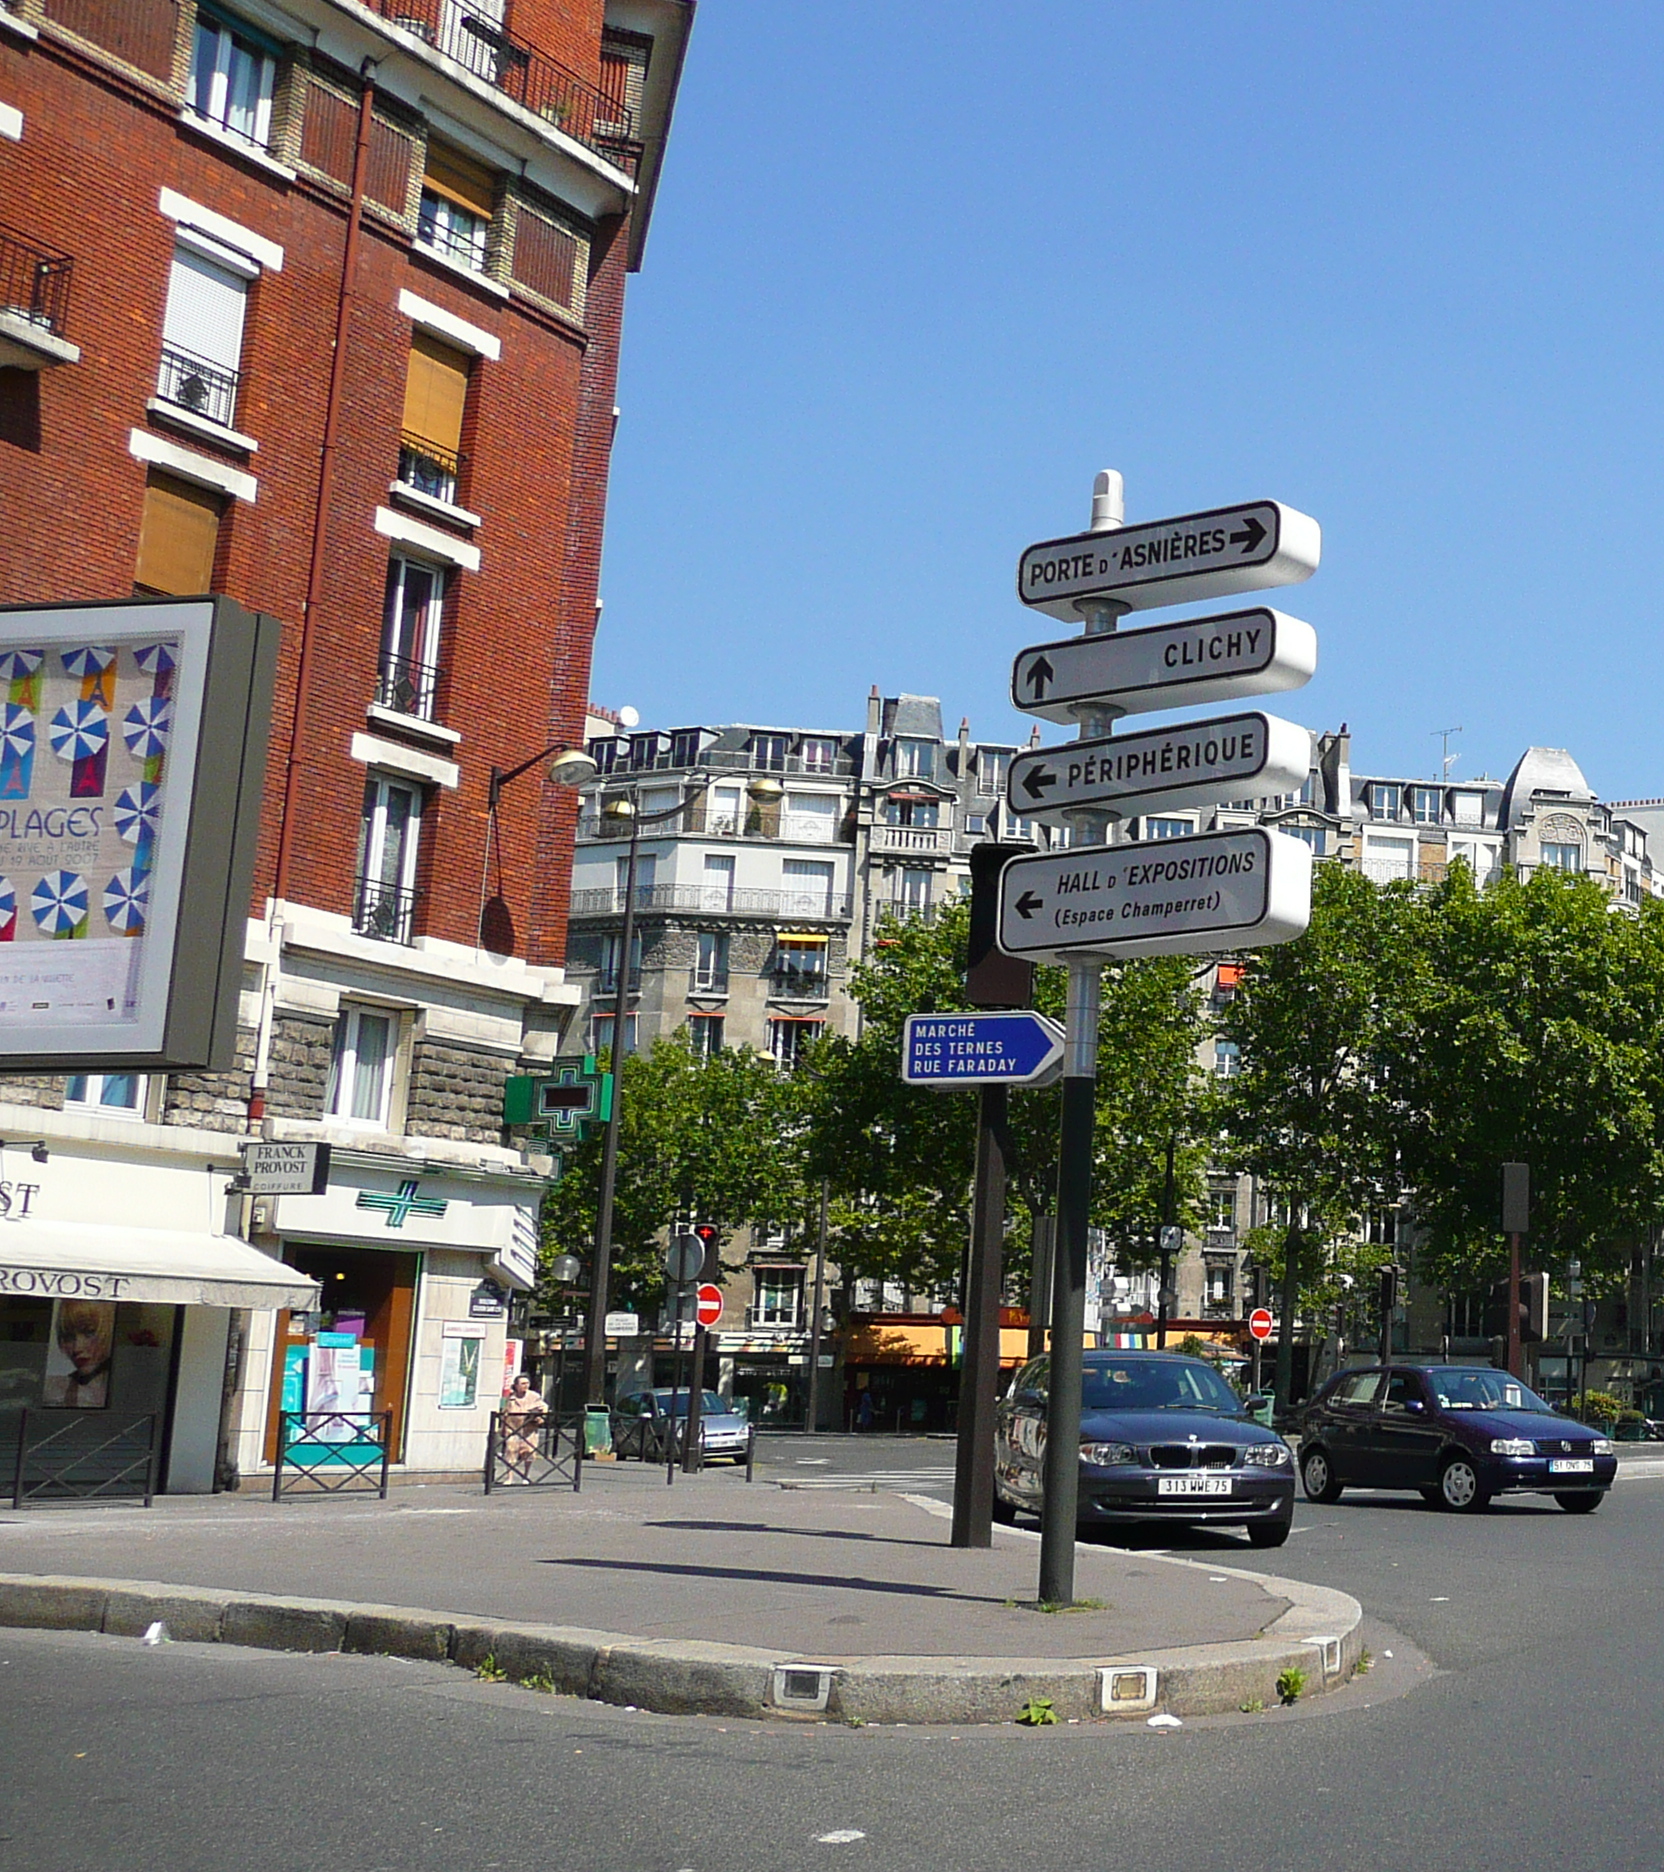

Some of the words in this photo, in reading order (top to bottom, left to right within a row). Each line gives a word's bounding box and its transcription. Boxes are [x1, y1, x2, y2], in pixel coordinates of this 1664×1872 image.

[1030, 553, 1094, 587] PORTE
[1164, 629, 1261, 668] CLICHY
[1068, 733, 1254, 788] PÉRIPHÉRIQUE
[1057, 871, 1100, 894] HALL
[1054, 908, 1114, 928] (Espace
[1121, 891, 1220, 919] Champerret)
[915, 1043, 942, 1056] DES
[949, 1041, 1003, 1055] TERNES
[914, 1060, 941, 1073] RUE
[948, 1058, 1017, 1072] FARADAY
[257, 1145, 306, 1160] FRANCK
[253, 1161, 308, 1174] PROVOST
[1166, 1480, 1187, 1492] 313
[1190, 1480, 1211, 1492] WWE
[1215, 1480, 1227, 1492] 75
